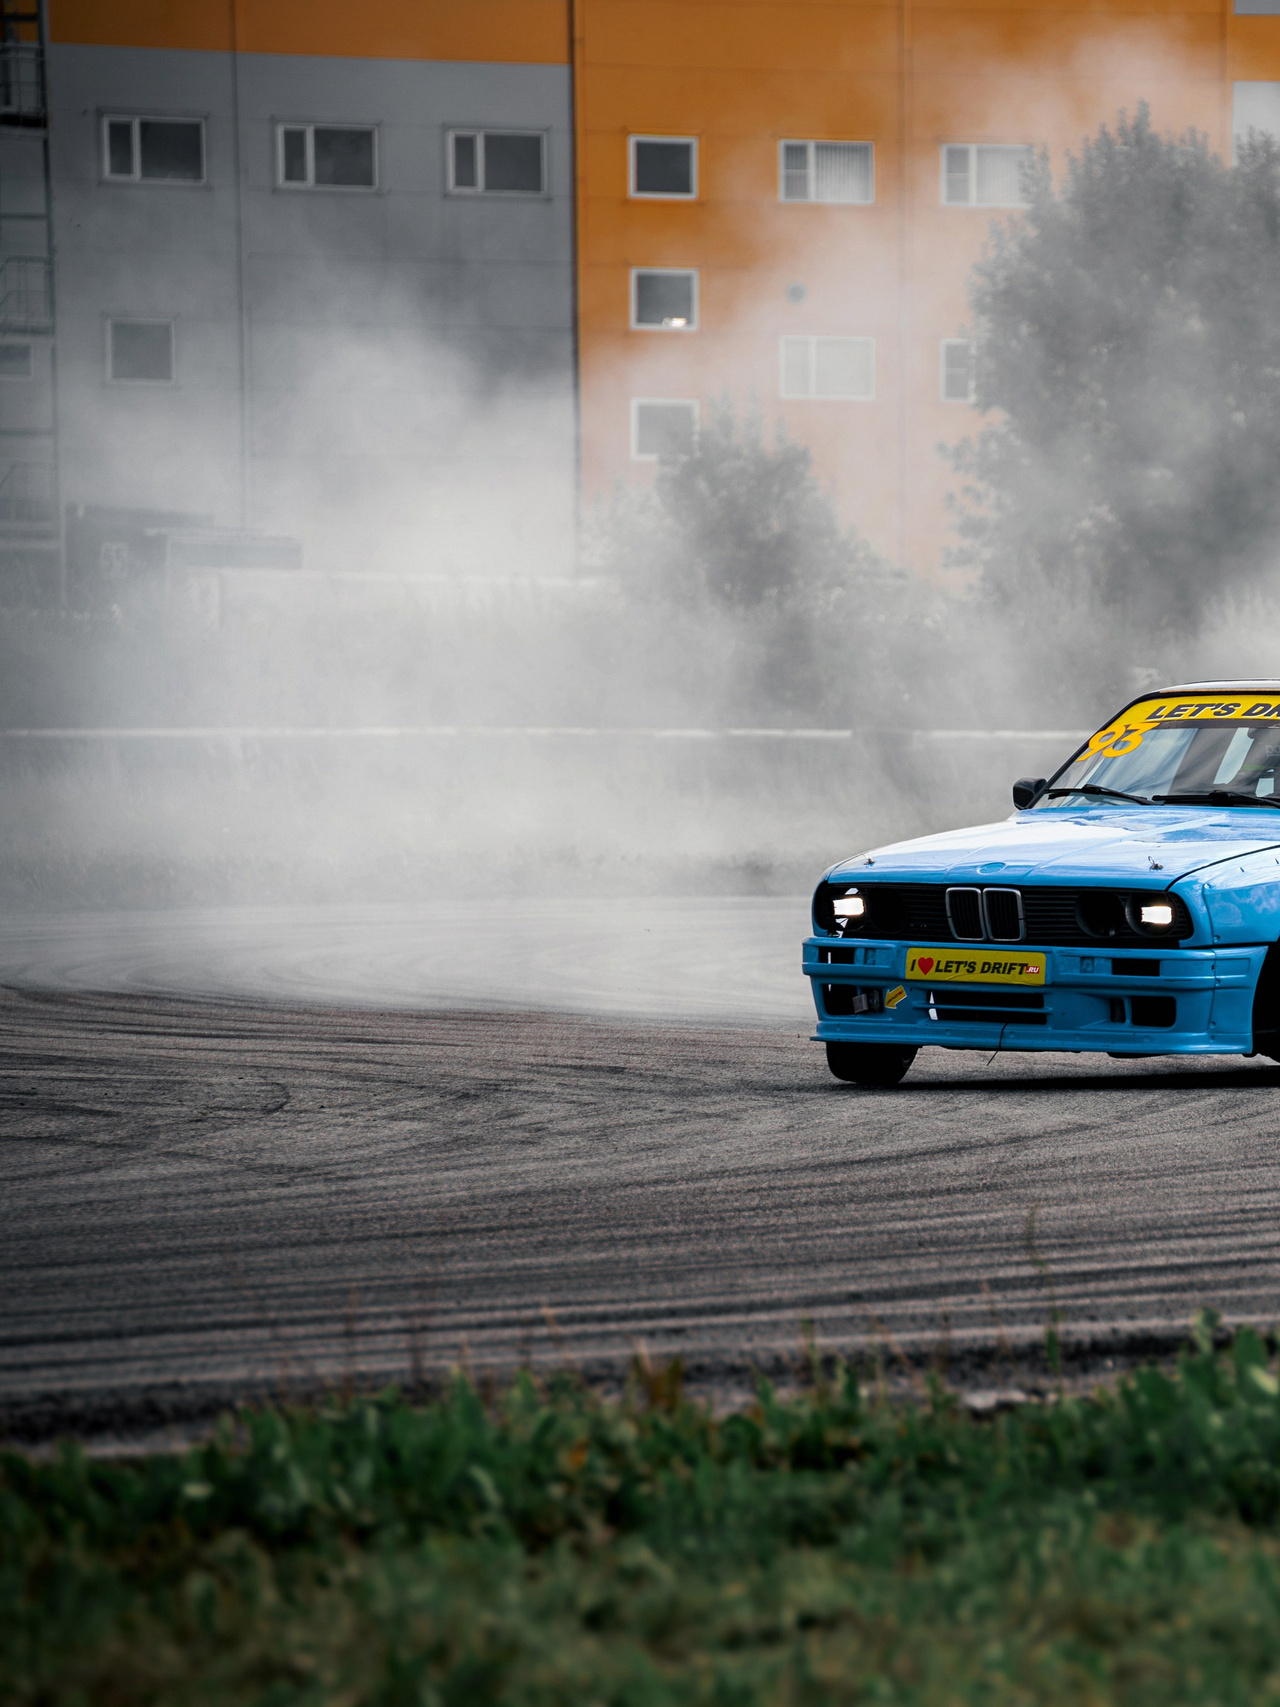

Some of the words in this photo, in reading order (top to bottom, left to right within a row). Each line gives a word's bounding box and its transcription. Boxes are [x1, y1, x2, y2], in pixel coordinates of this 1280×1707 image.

[1147, 702, 1240, 720] LET'S
[1075, 722, 1161, 762] 93
[910, 959, 916, 972] I
[934, 960, 977, 974] LET'S
